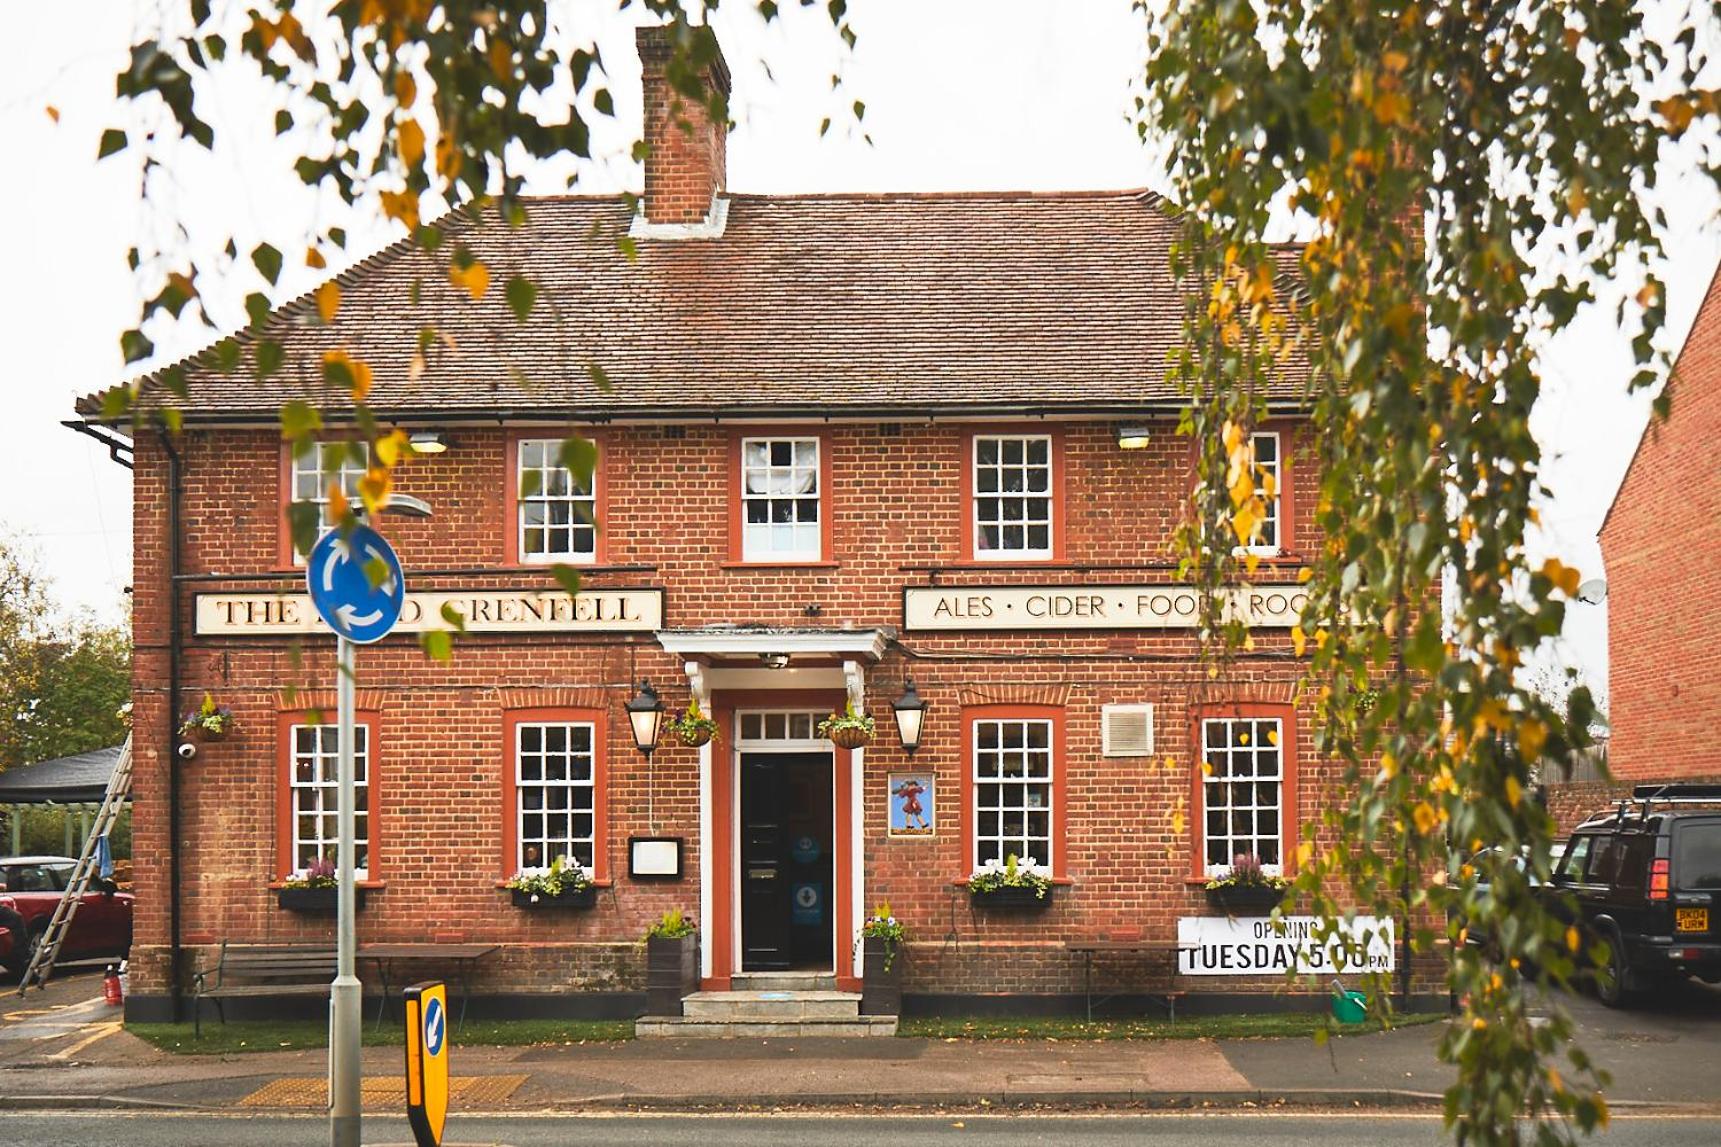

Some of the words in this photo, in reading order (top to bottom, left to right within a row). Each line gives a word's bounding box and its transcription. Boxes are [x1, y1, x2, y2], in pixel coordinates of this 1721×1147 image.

[216, 600, 299, 625] THE
[934, 596, 993, 617] ALES
[1026, 596, 1106, 617] CIDER
[1187, 944, 1302, 968] TUESDAY
